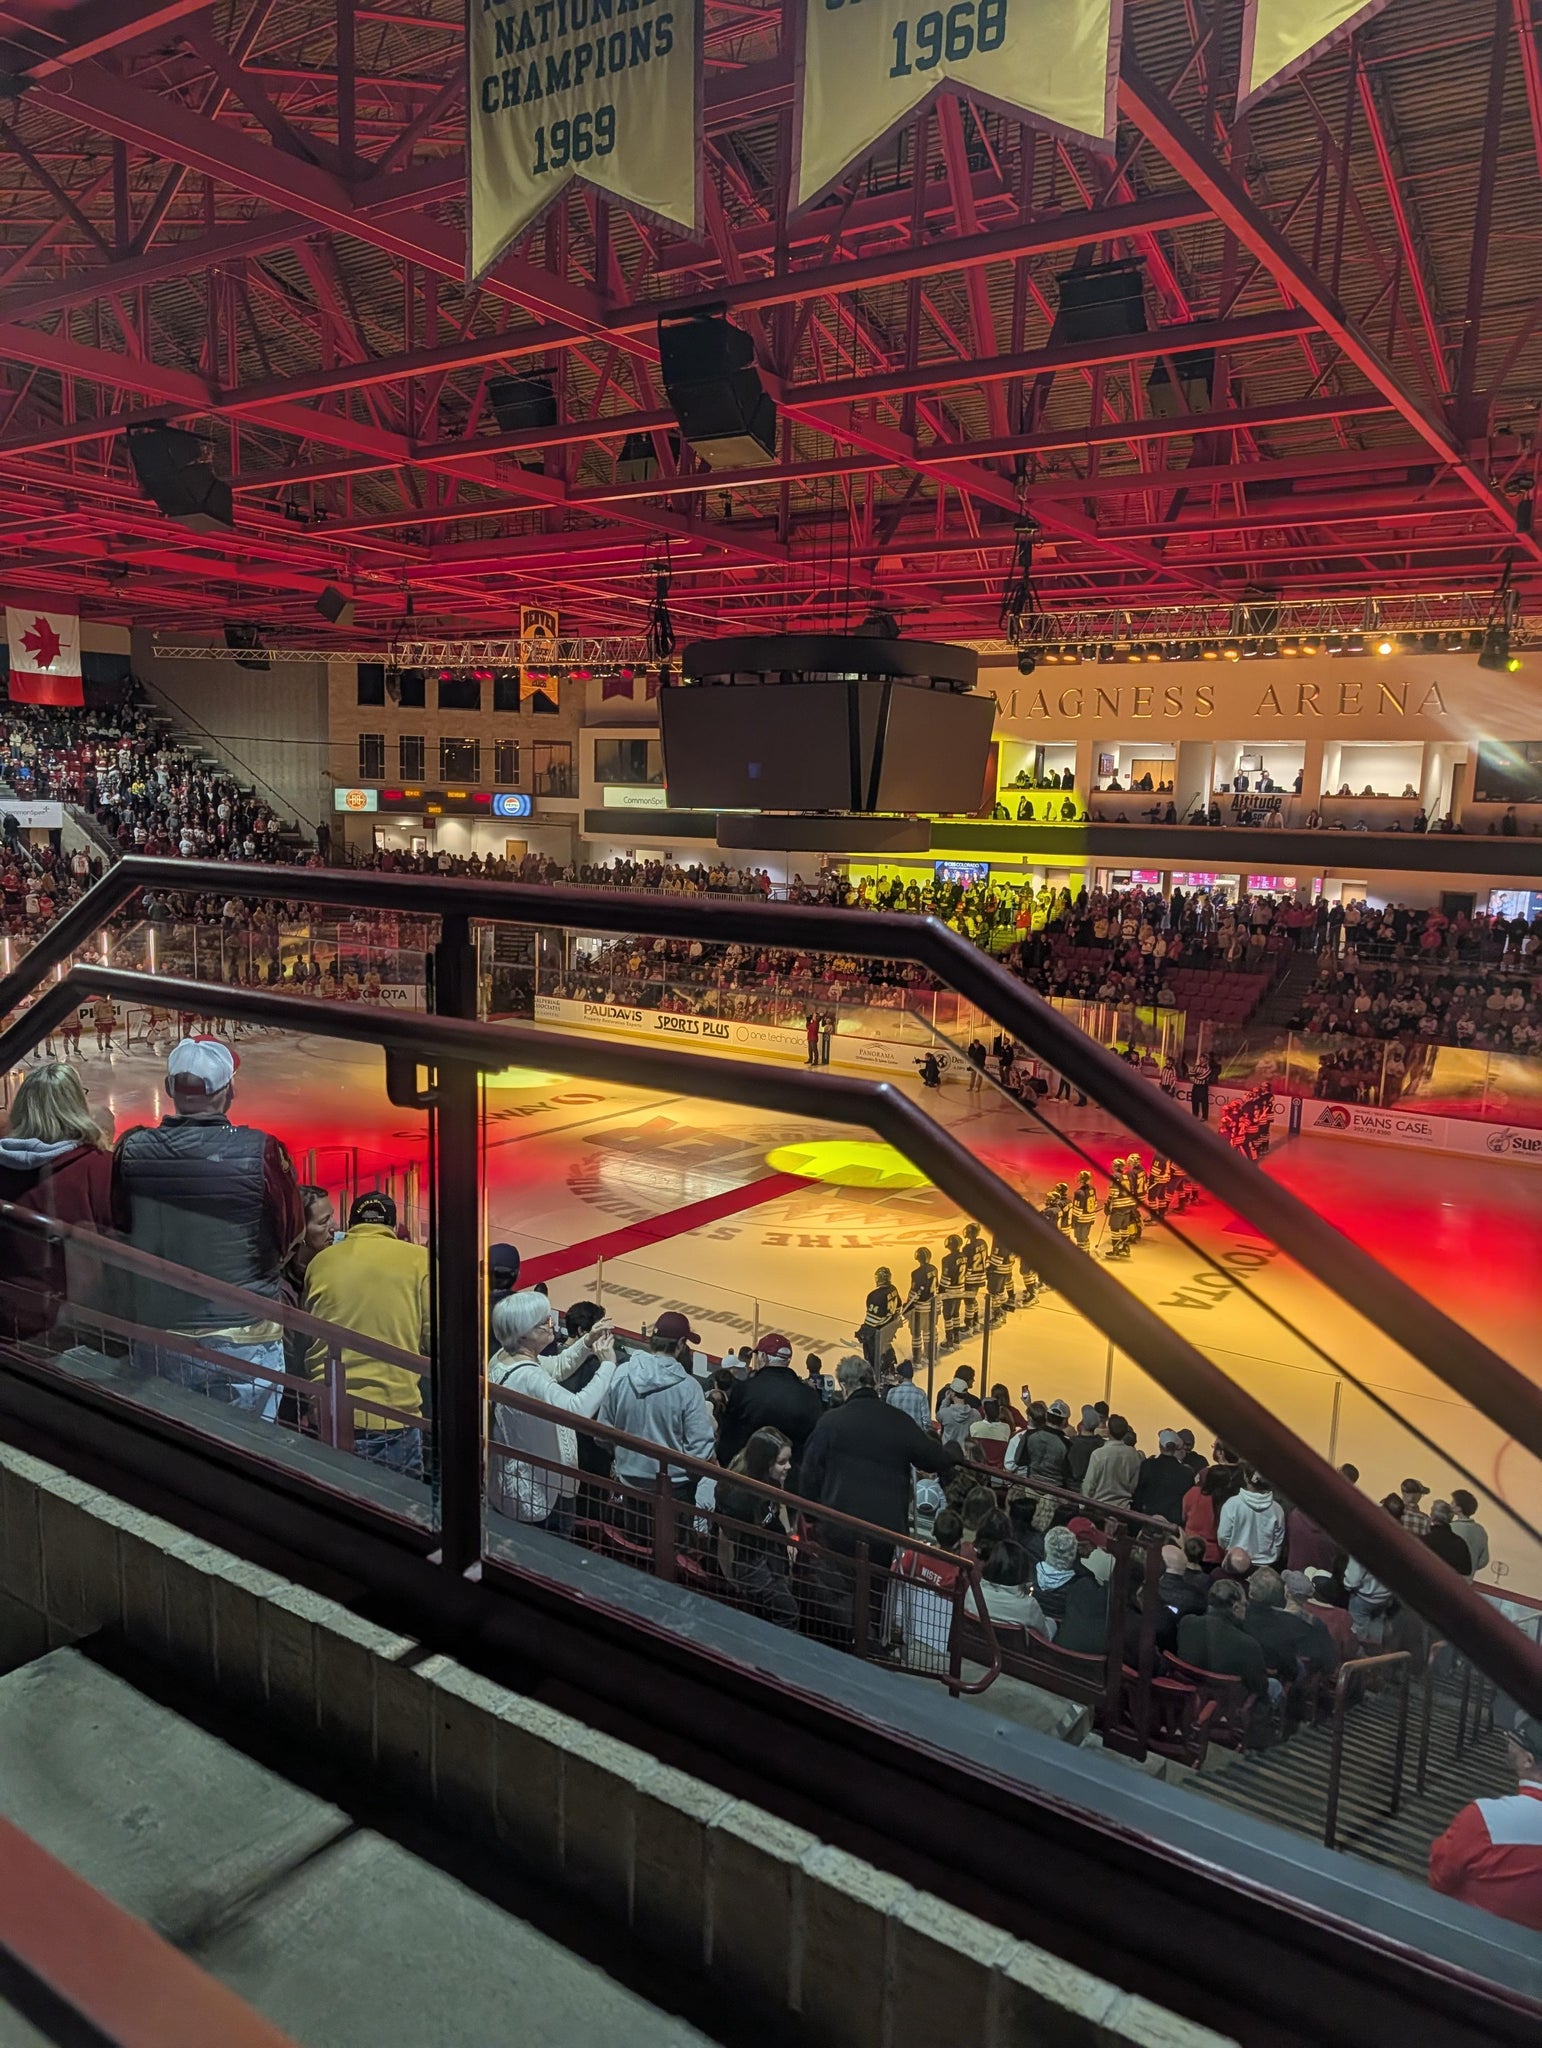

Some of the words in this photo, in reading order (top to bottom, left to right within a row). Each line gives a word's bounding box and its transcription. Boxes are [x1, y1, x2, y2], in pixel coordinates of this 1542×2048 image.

[495, 0, 655, 59] NATION
[890, 0, 1007, 78] 1968
[482, 13, 674, 114] CHAMPIONS
[533, 104, 616, 176] 1969
[988, 685, 1216, 719] MAGNESS
[1252, 680, 1449, 717] ARENA
[1231, 794, 1282, 809] Altitude
[359, 989, 407, 999] TOOTA
[654, 1015, 699, 1034] SPORTS
[702, 1022, 730, 1039] PLUS
[751, 1031, 767, 1041] one
[859, 1049, 895, 1059] PANORAMA
[1353, 1115, 1392, 1129] EVANS
[1396, 1120, 1429, 1134] CASE
[761, 1231, 873, 1249] THE
[1157, 1244, 1280, 1310] TOYOTA
[584, 1280, 664, 1306] Bank
[868, 1303, 879, 1313] 34
